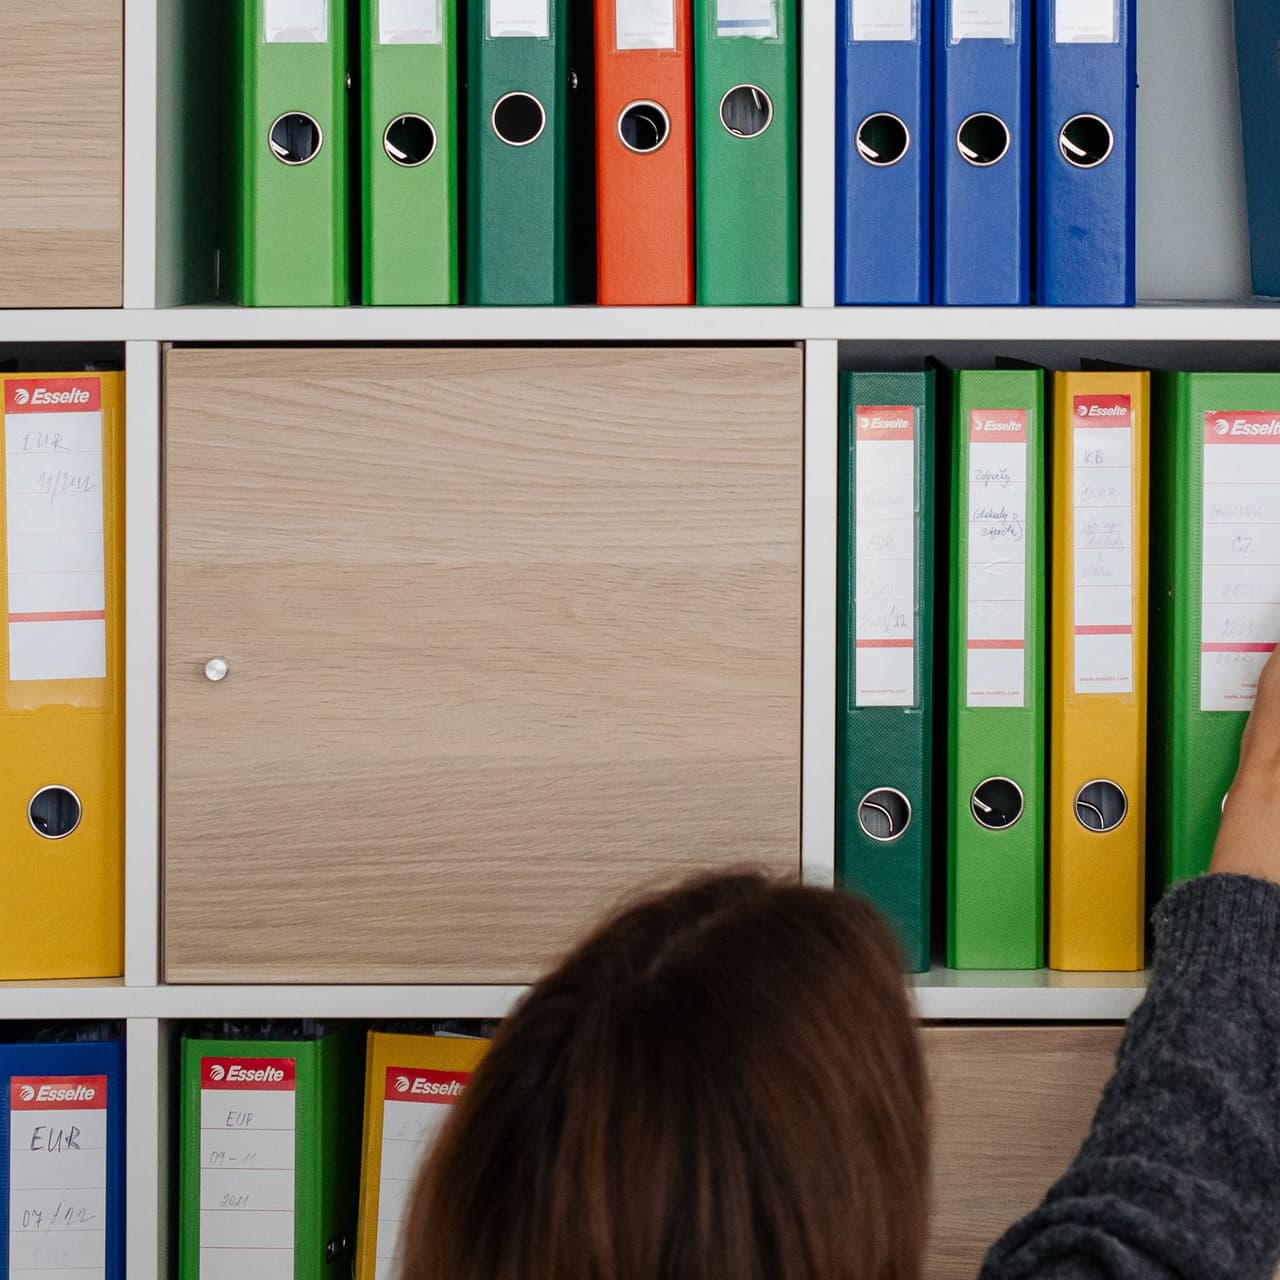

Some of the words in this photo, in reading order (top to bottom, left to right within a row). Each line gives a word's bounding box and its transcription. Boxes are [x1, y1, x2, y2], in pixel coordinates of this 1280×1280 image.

[31, 388, 90, 405] Esselte
[1088, 405, 1127, 418] Esselte
[870, 417, 909, 430] Esselte
[983, 419, 1022, 432] Esselte
[21, 431, 70, 451] EUR
[226, 1066, 284, 1083] Esselte
[36, 1085, 95, 1102] Esselte
[30, 1125, 81, 1153] EUR
